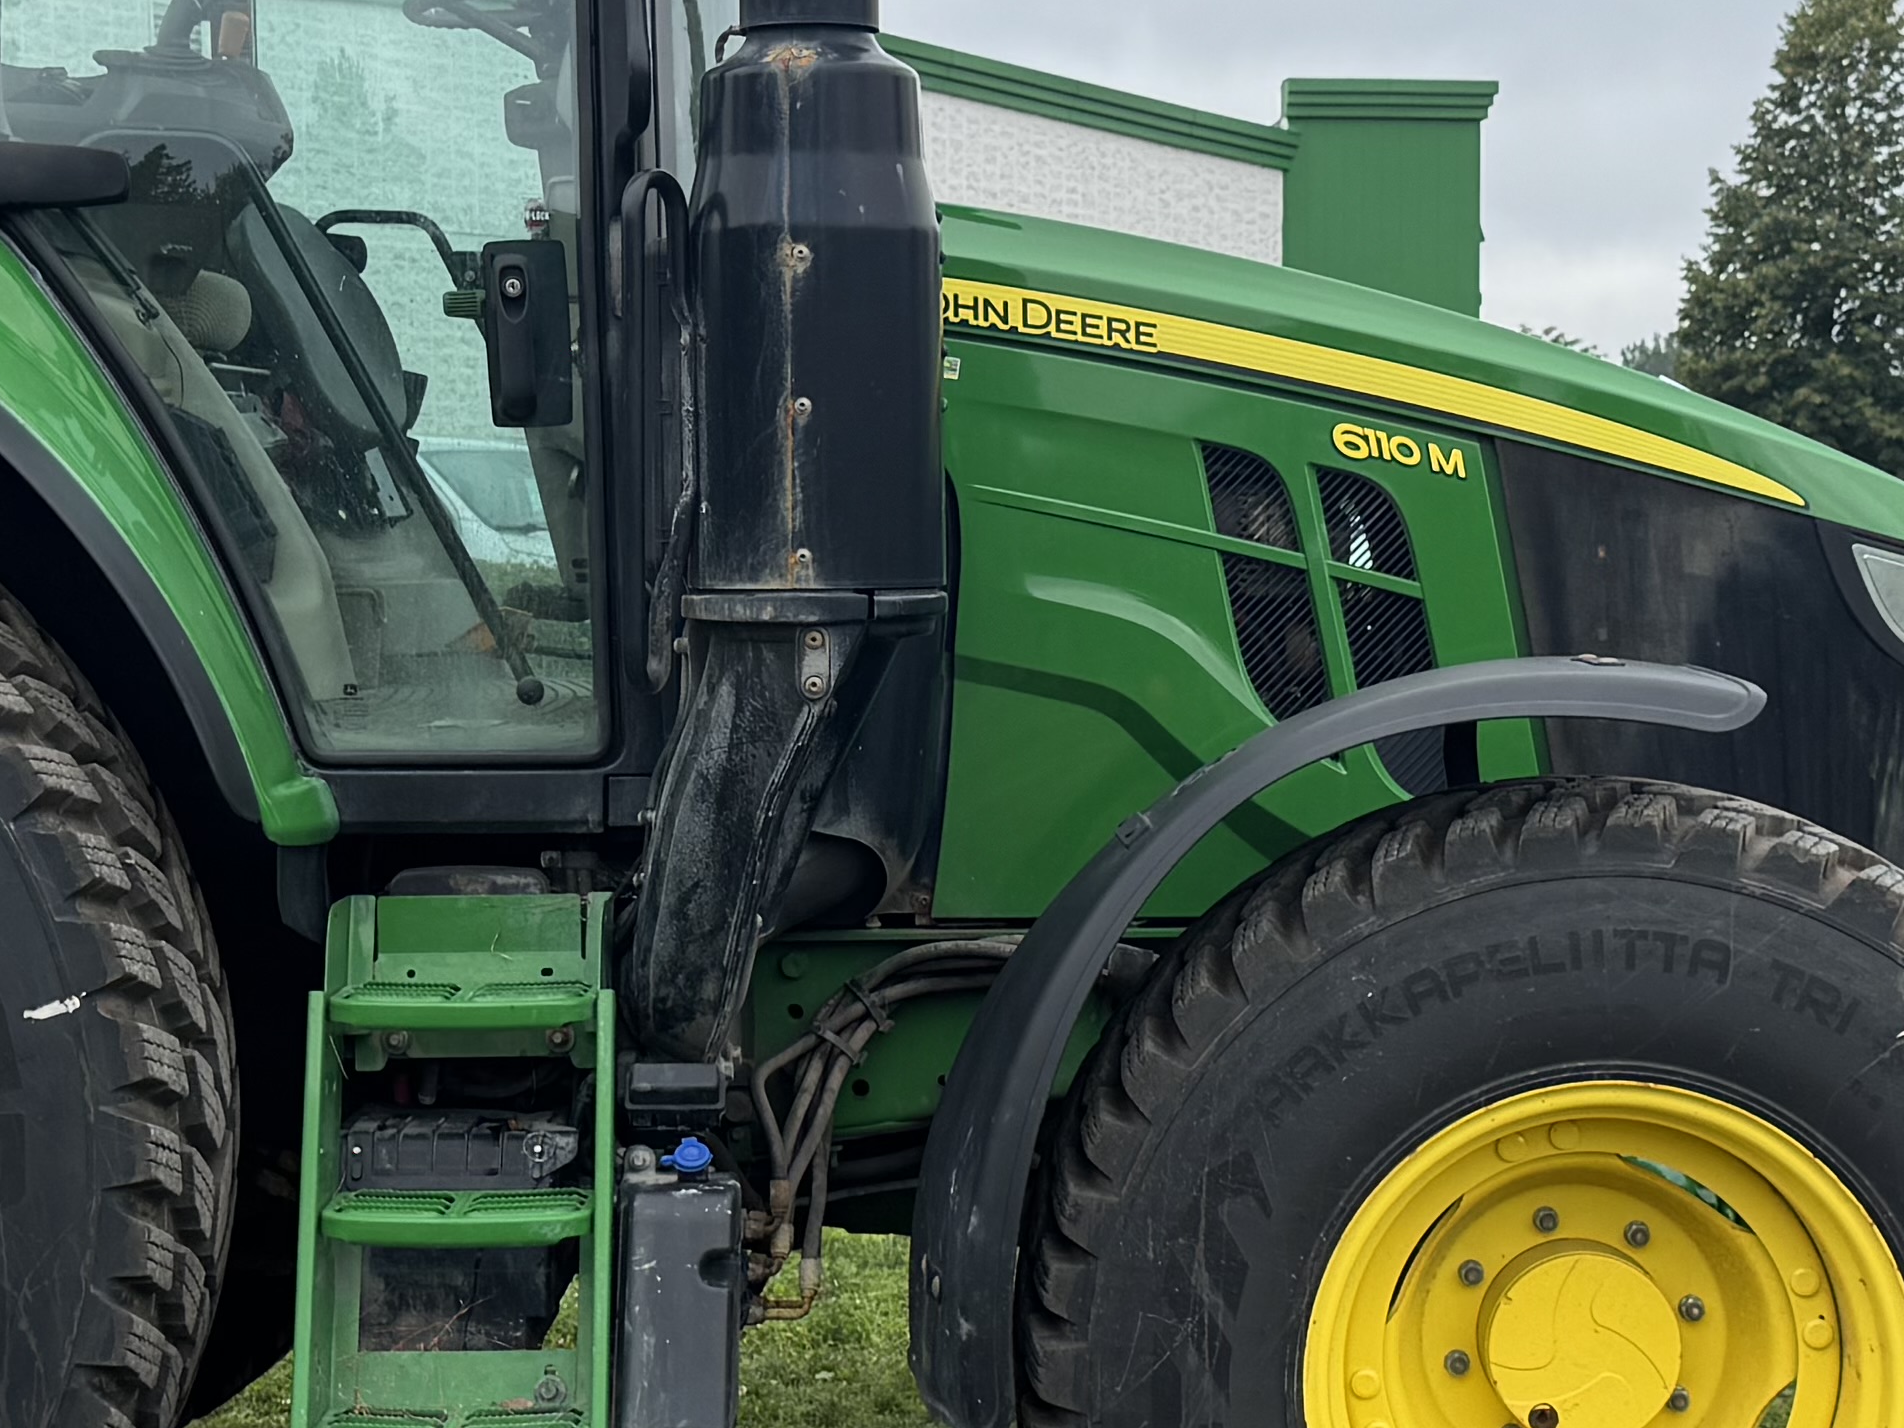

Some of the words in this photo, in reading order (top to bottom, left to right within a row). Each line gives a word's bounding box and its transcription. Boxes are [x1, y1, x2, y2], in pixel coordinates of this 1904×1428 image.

[942, 292, 1009, 326] HN
[1022, 297, 1158, 348] DEERE
[1332, 422, 1422, 466] 6110
[1427, 442, 1467, 479] M
[1245, 923, 1737, 1132] HAKKAPELIITTA
[1759, 956, 1865, 1038] TRI
